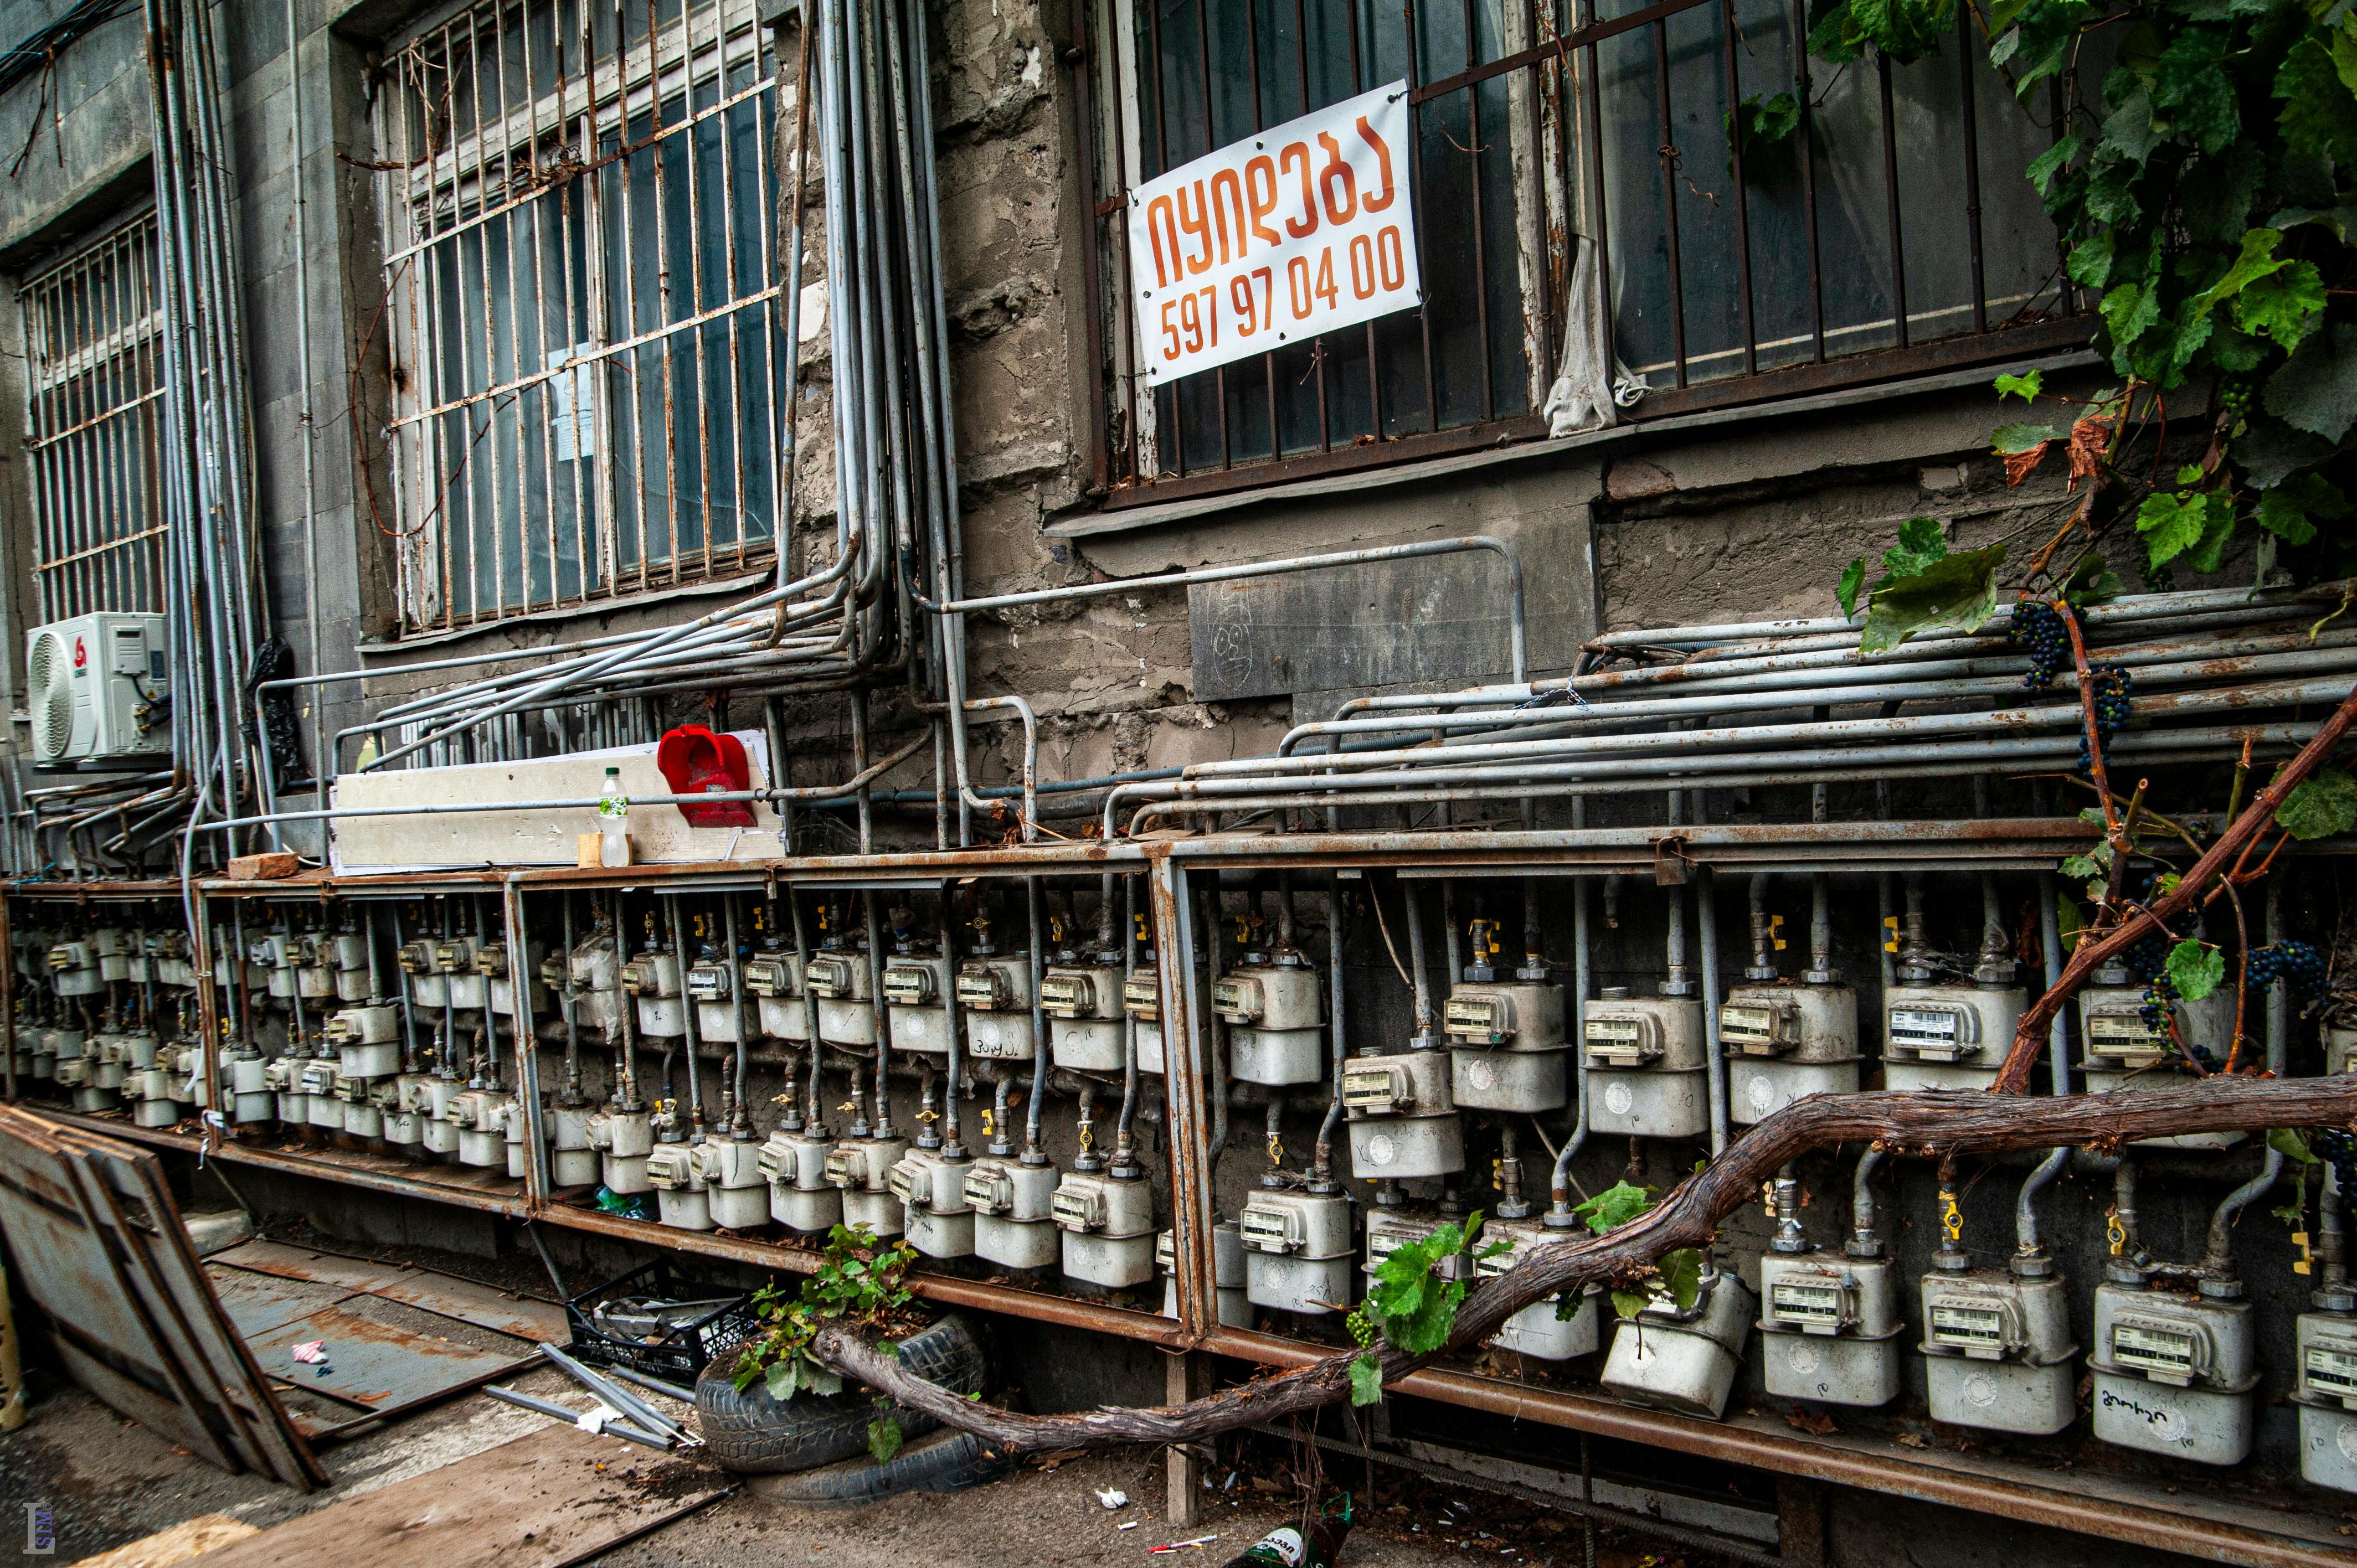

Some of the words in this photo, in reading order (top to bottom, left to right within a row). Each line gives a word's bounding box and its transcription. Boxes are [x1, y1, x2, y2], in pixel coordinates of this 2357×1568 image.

[1147, 115, 1395, 289] იყიდება
[1161, 283, 1217, 361] 597
[1229, 265, 1272, 337] 97
[1287, 246, 1339, 320] 04
[1349, 225, 1405, 300] 00
